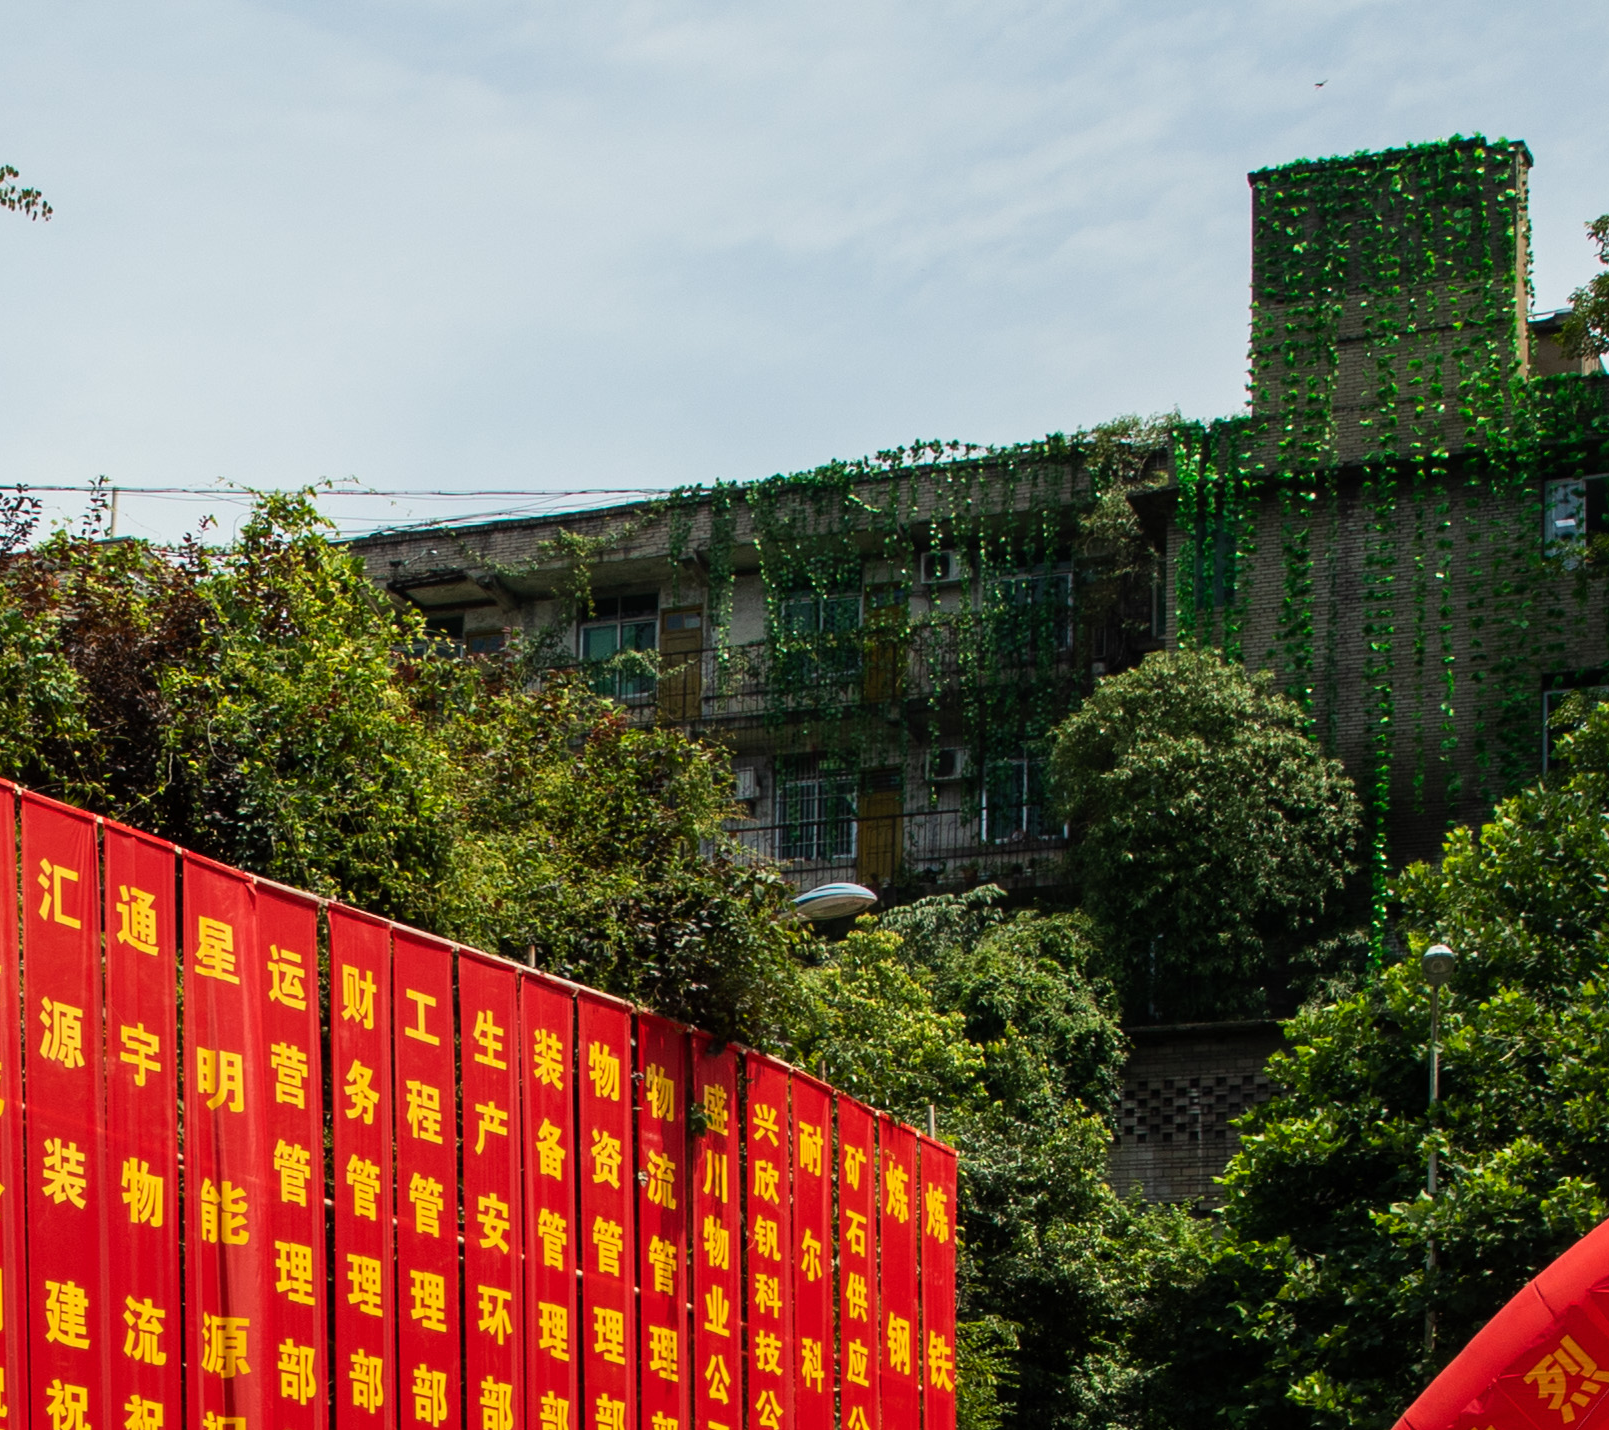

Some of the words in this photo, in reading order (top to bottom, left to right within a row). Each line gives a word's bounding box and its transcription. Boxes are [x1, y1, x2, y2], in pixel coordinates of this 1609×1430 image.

[38, 859, 90, 1349] 汇源装建
[117, 886, 166, 1365] 通宇物流
[195, 916, 250, 1378] 星明能源
[268, 945, 316, 1405] 运营管理部
[342, 965, 383, 1413] 财务管理部
[405, 989, 447, 1427] 工程管理部
